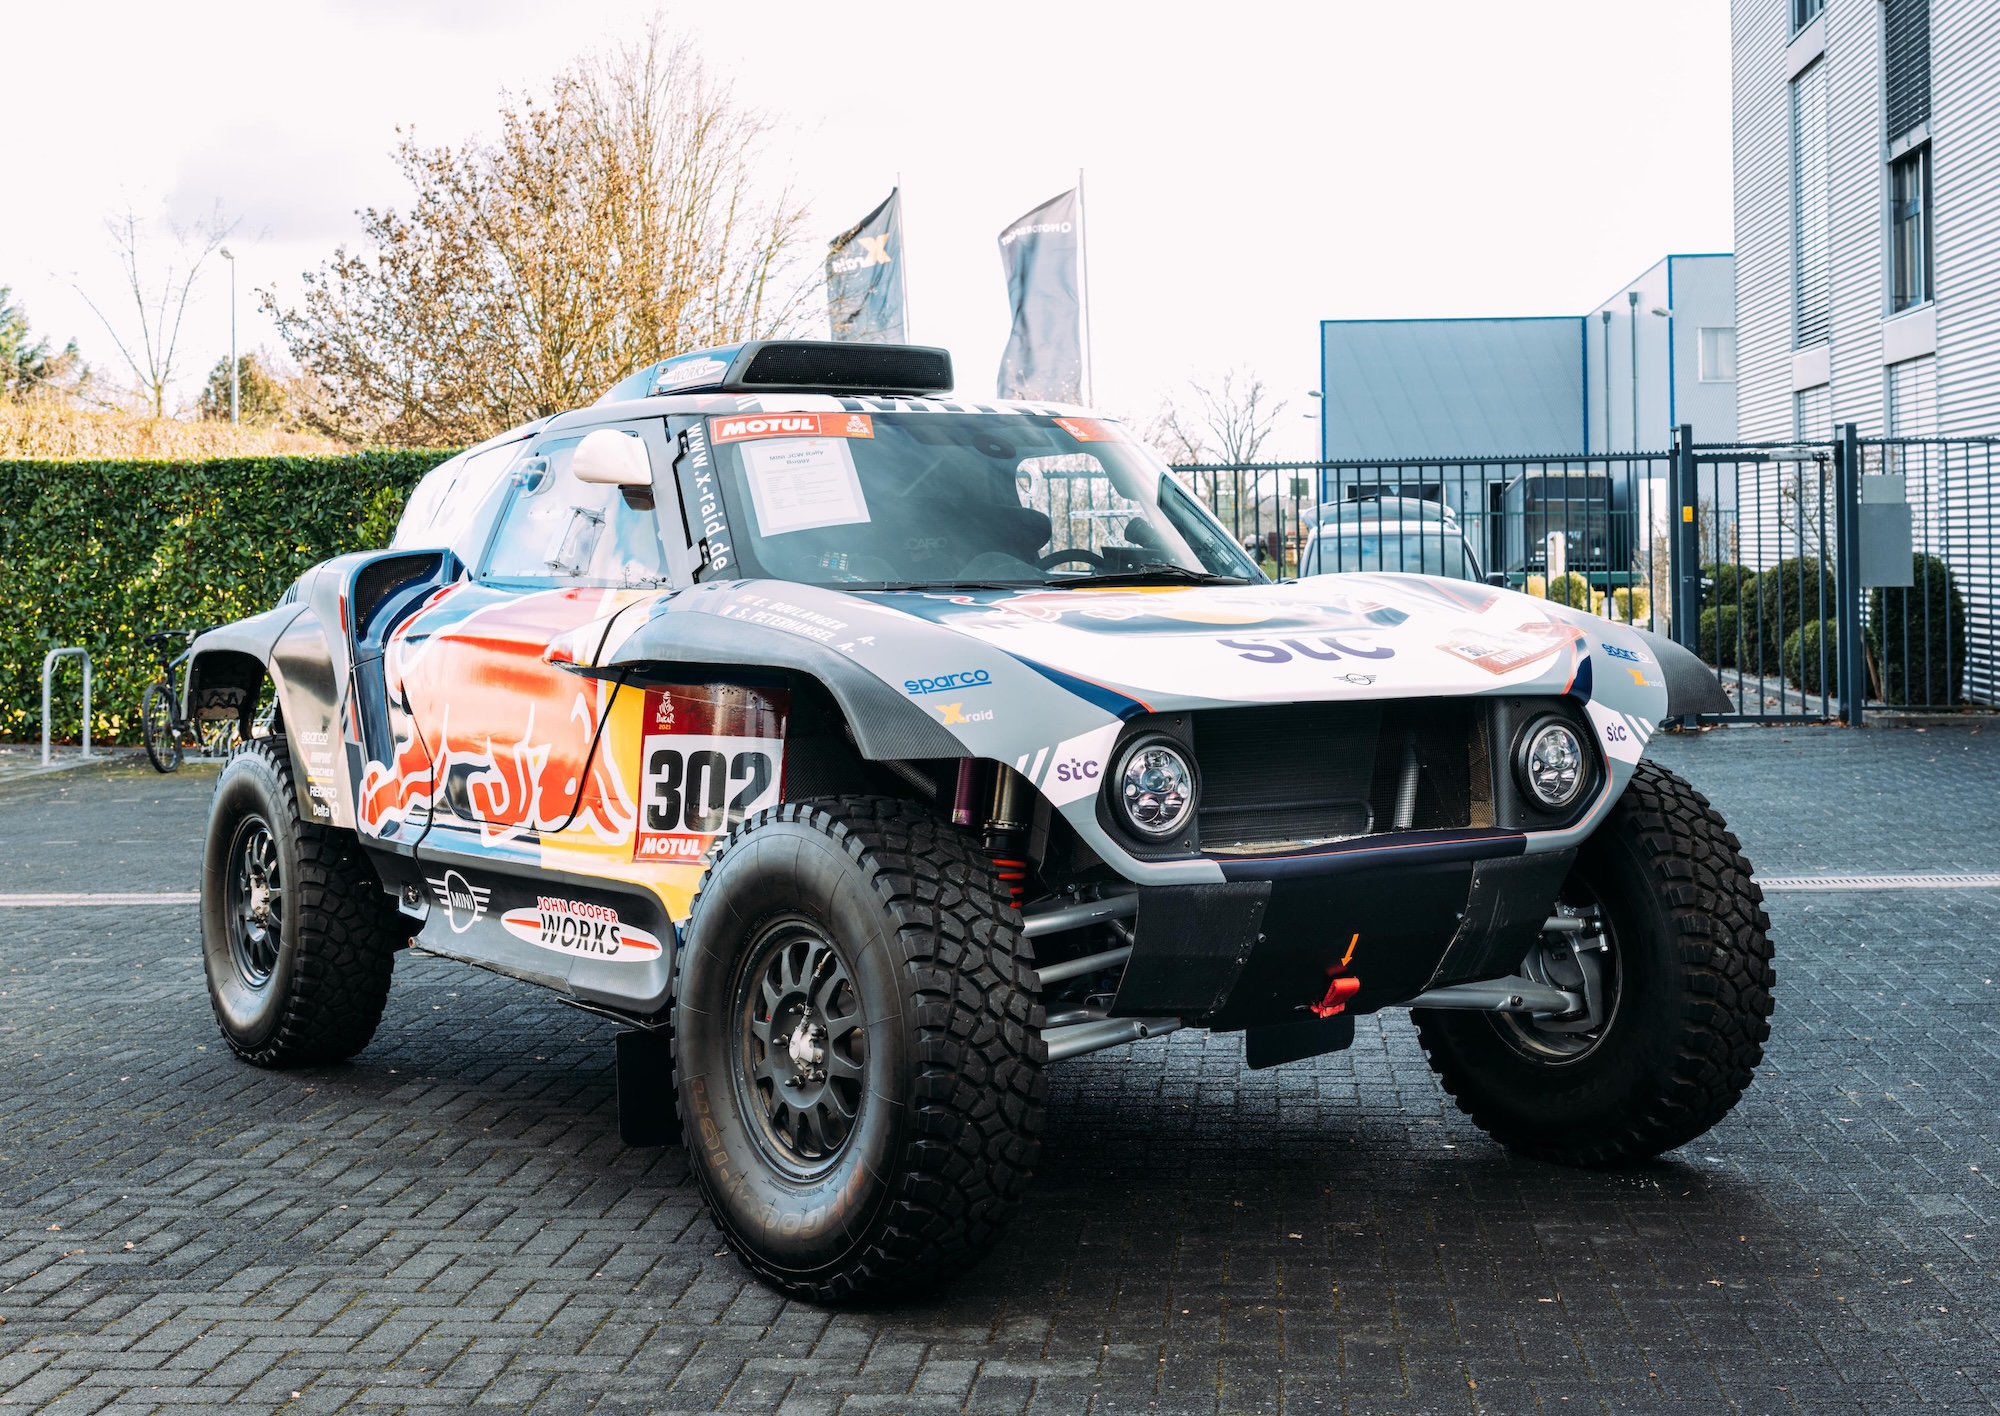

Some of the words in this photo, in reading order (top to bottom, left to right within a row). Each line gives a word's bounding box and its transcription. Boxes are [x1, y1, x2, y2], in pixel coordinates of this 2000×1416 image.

[721, 418, 815, 437] MOTUL
[687, 422, 731, 571] www.x-raid.de
[735, 607, 747, 619] S.
[748, 610, 837, 642] PETERHANSEL
[768, 601, 849, 631] BOULANGER
[904, 669, 991, 695] sparco
[656, 712, 676, 724] DAKAR
[658, 723, 672, 731] 2021
[1606, 722, 1627, 742] stc
[1056, 758, 1099, 782] stc
[646, 749, 772, 833] 302
[312, 803, 330, 818] Delta
[640, 837, 702, 857] MOTUL
[450, 890, 474, 911] MINI
[537, 897, 569, 914] JOHN
[571, 902, 619, 923] COOPER
[540, 913, 620, 955] WORKS
